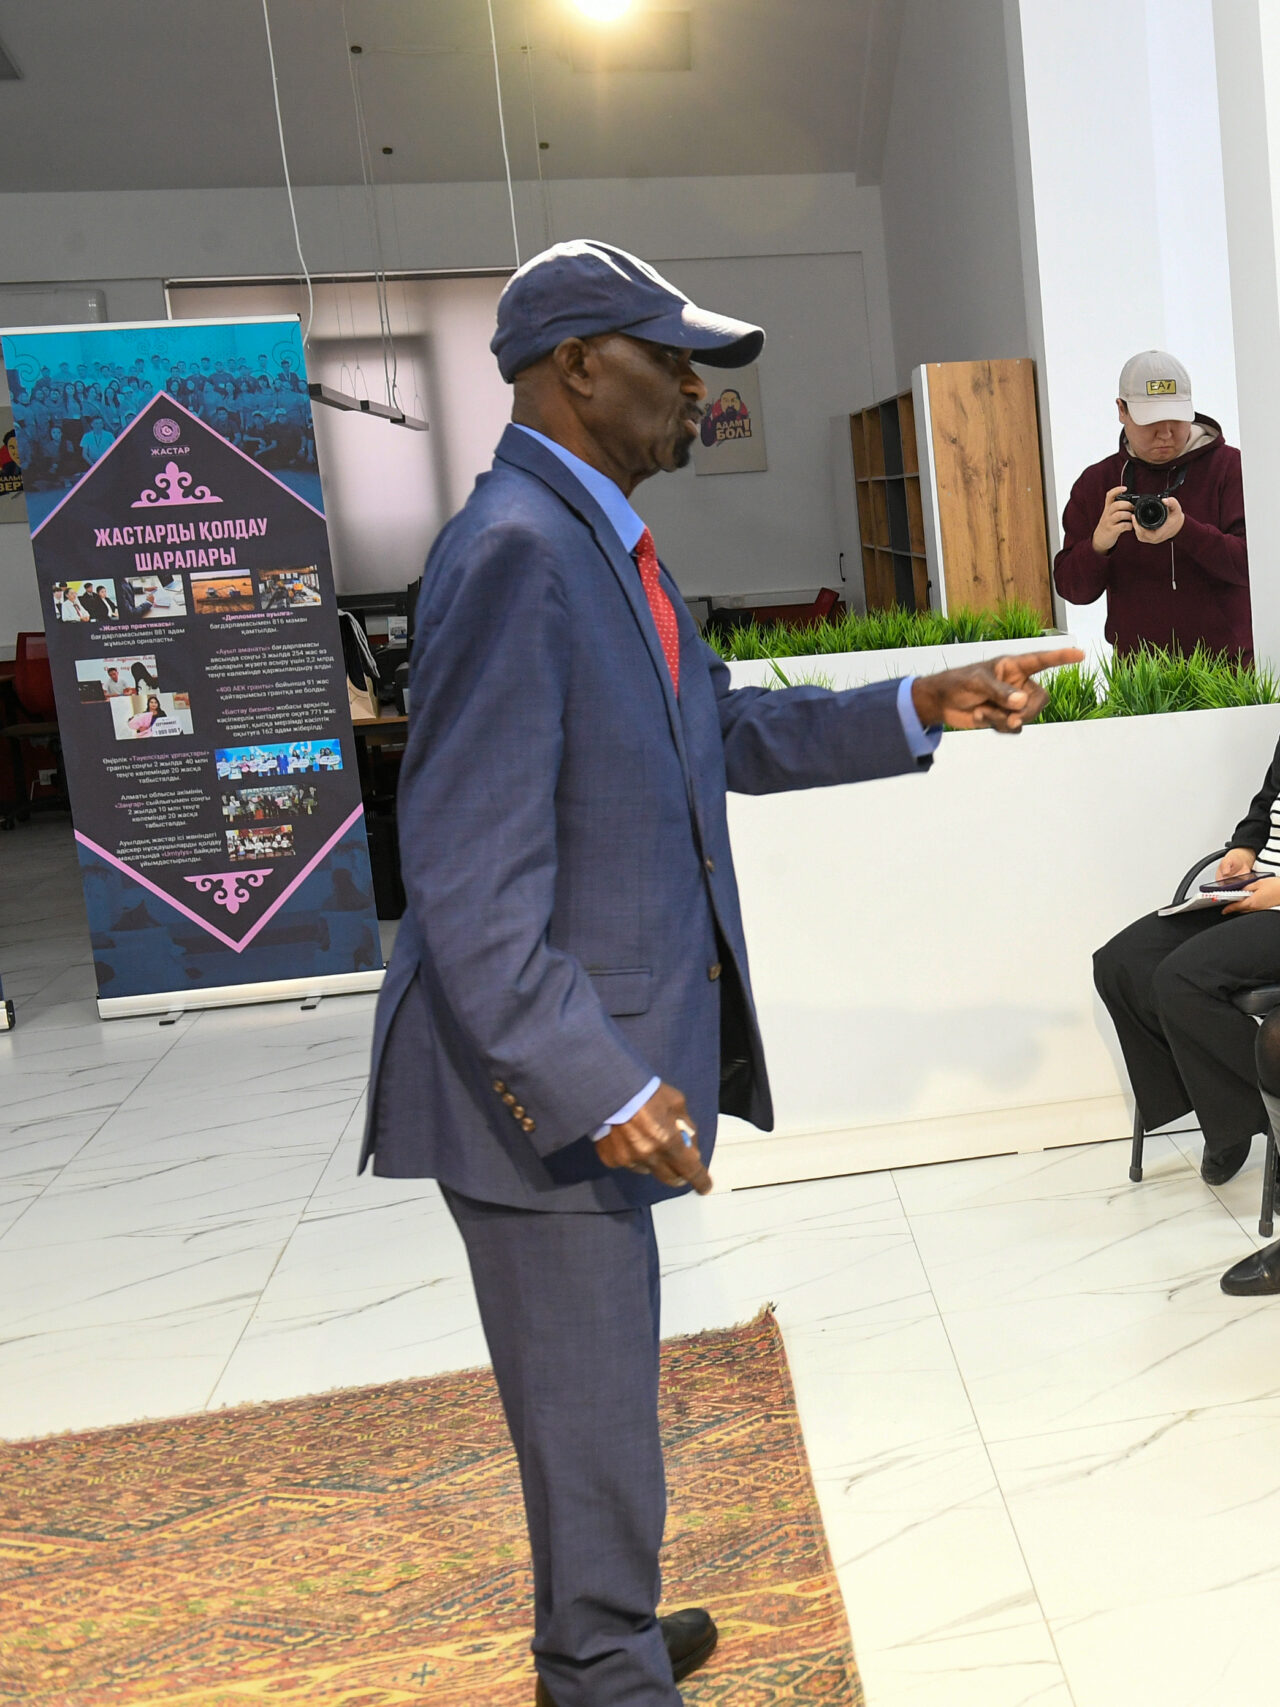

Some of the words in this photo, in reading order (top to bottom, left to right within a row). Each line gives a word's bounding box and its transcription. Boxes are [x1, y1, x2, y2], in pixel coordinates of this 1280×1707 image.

[716, 419, 751, 440] БОЛ!
[151, 447, 190, 456] ЖАСТАР
[94, 523, 196, 547] ЖАСТАРДЫ
[199, 518, 268, 542] ҚОЛДАУ
[135, 547, 237, 571] ШАРАЛАРЫ
